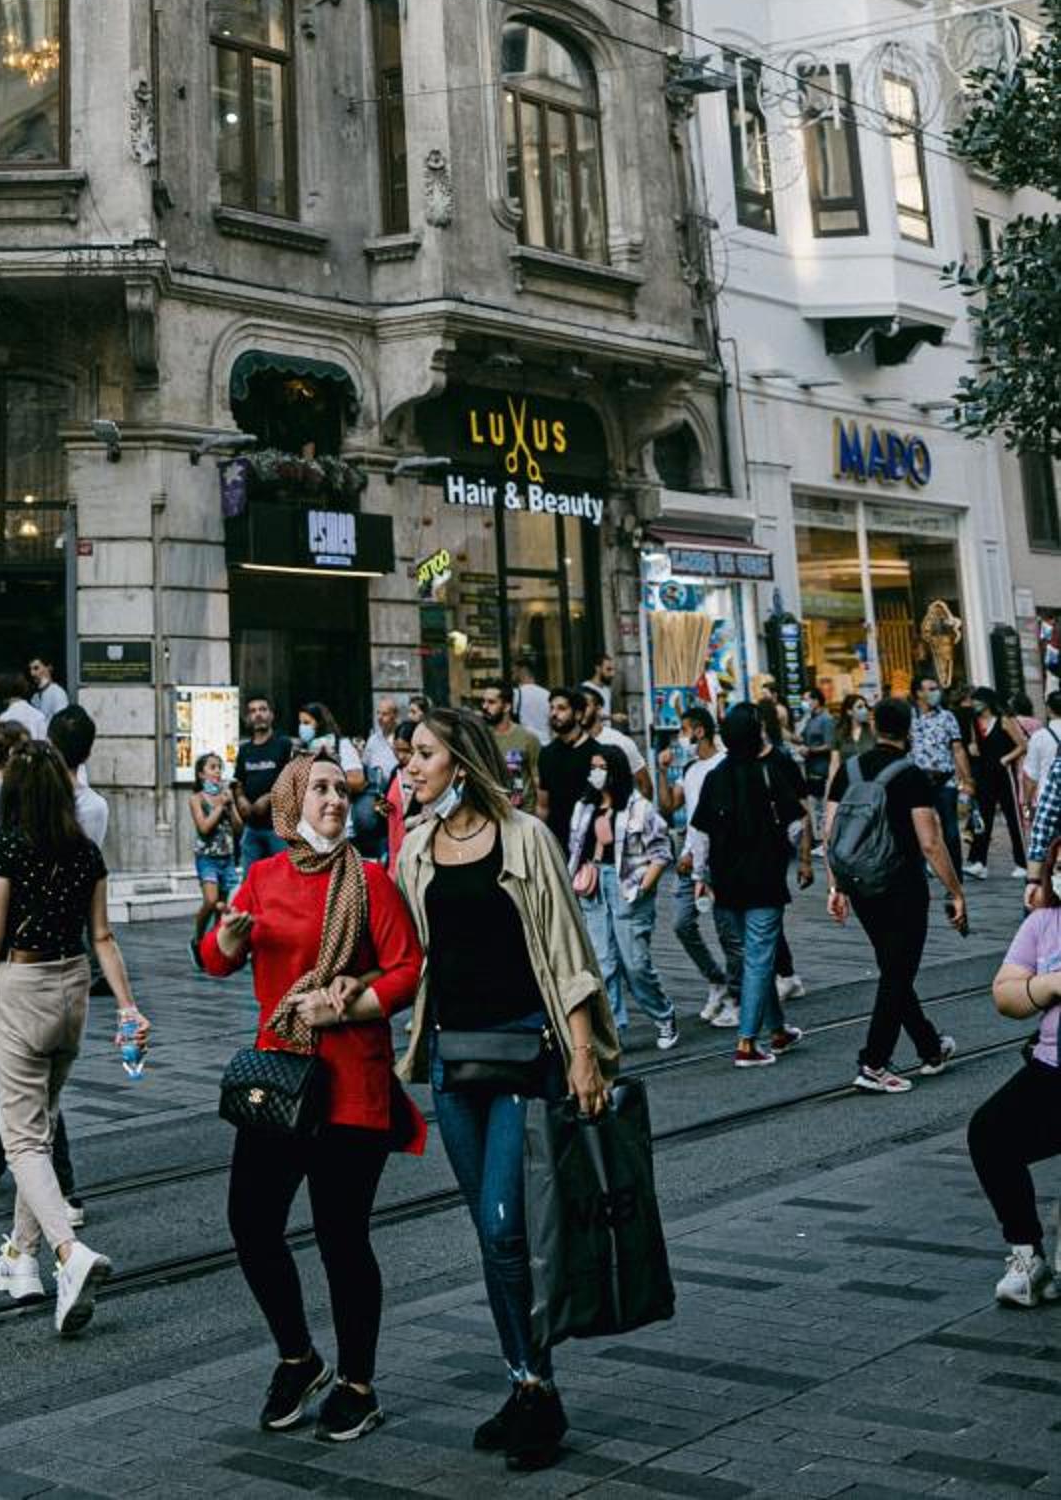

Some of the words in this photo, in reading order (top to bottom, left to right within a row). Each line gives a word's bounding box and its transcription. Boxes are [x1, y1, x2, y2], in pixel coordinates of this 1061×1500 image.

[832, 417, 932, 489] MADO
[446, 474, 497, 507] Hair
[504, 480, 522, 509] &
[527, 484, 604, 525] Beauty
